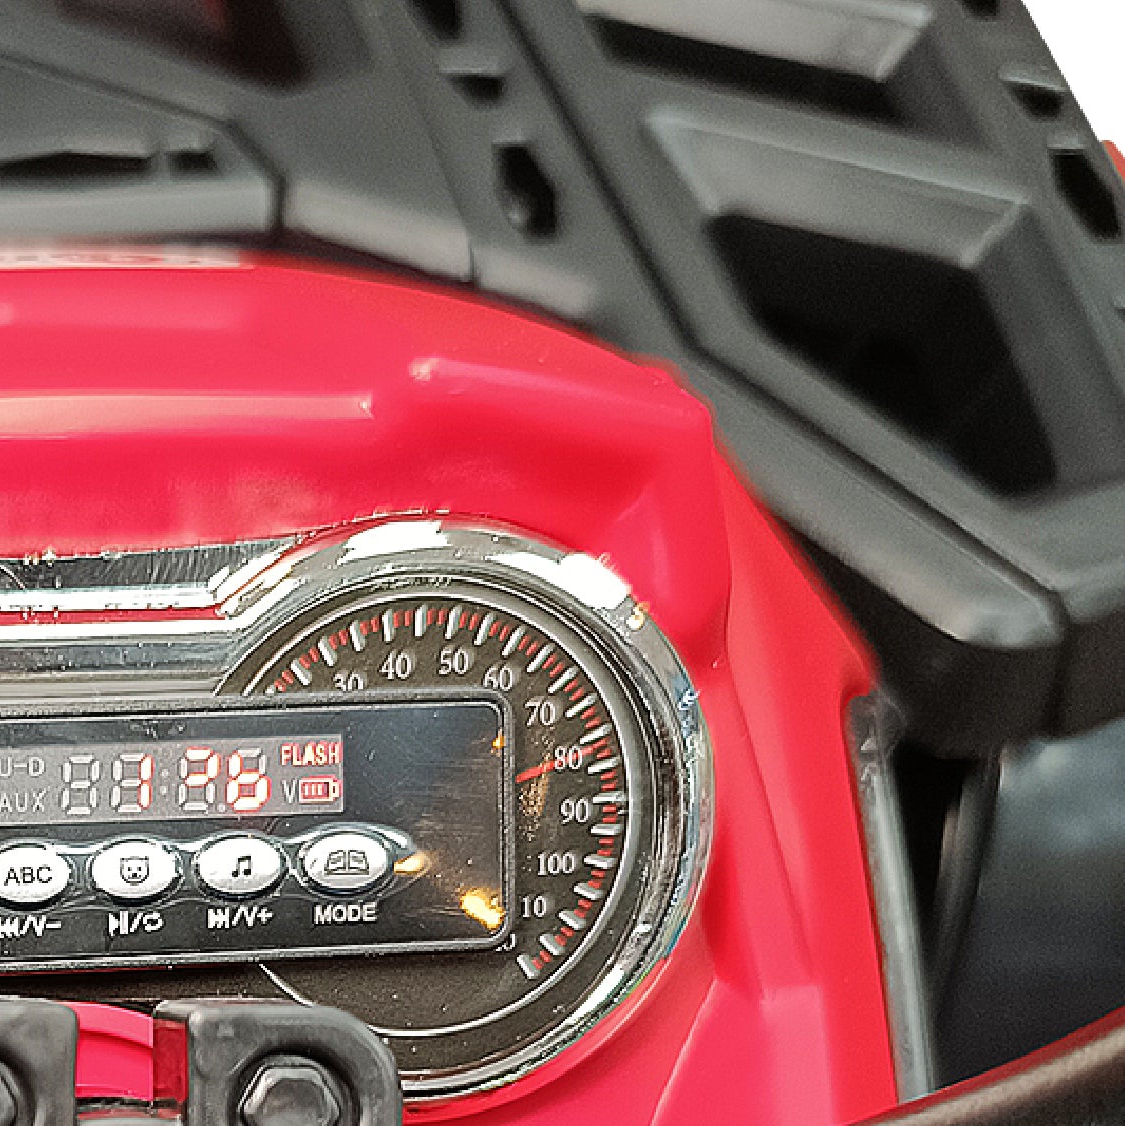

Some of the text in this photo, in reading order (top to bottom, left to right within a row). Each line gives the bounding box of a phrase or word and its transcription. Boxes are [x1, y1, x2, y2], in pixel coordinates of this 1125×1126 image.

[380, 651, 412, 680] 40
[438, 646, 469, 675] 50
[525, 700, 556, 726] 70
[279, 741, 343, 767] FLASH
[554, 746, 583, 770] 80
[561, 798, 590, 824] 90
[4, 866, 53, 886] ABC
[537, 851, 576, 876] 100
[313, 902, 378, 925] MODE
